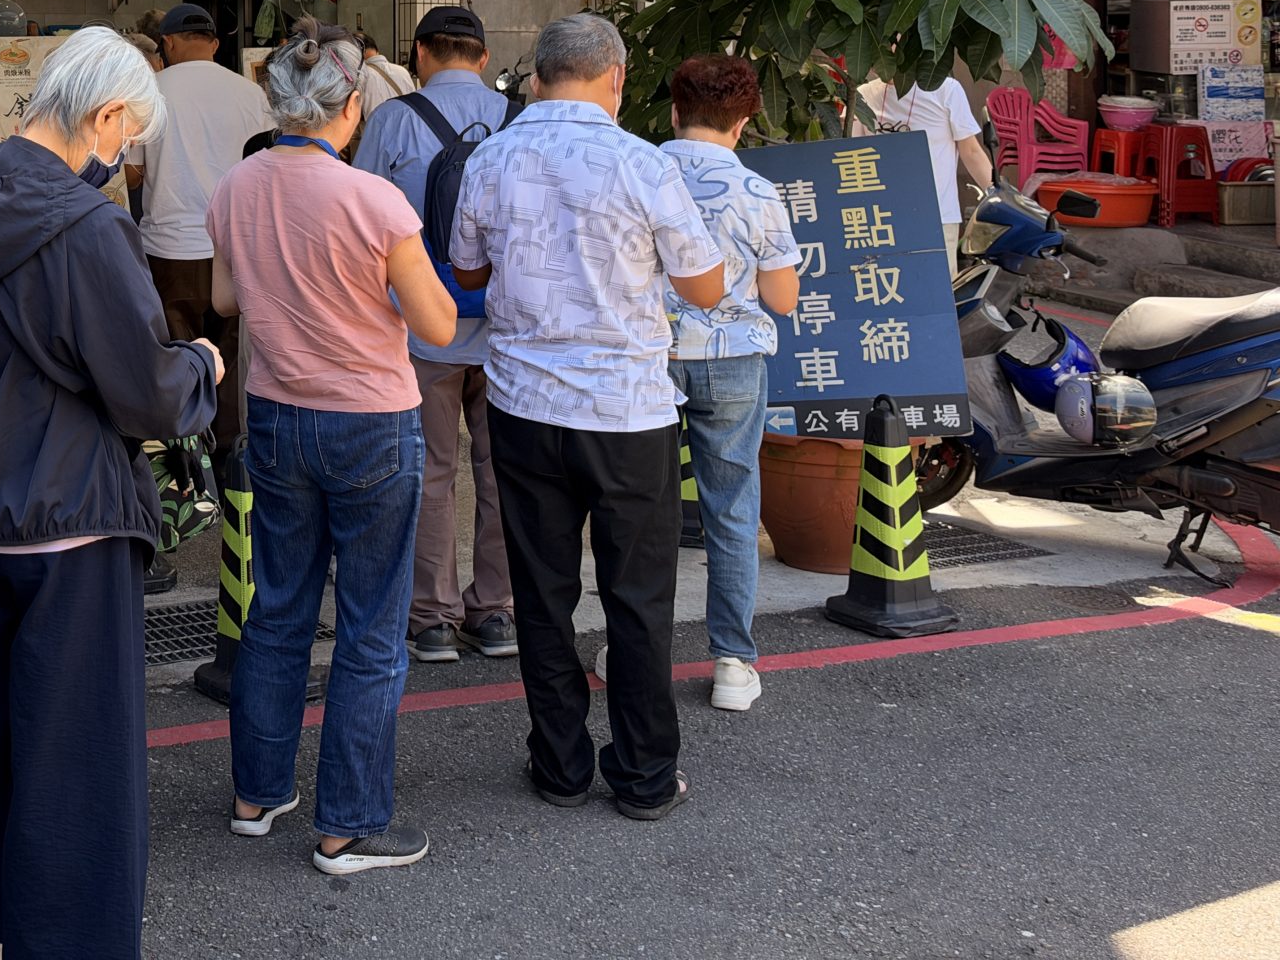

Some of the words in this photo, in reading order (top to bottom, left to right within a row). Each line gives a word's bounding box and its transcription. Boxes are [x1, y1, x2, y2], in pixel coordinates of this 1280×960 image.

[775, 179, 844, 392] 請勿停車
[832, 147, 911, 364] 重點取締
[805, 404, 961, 433] 公有車場
